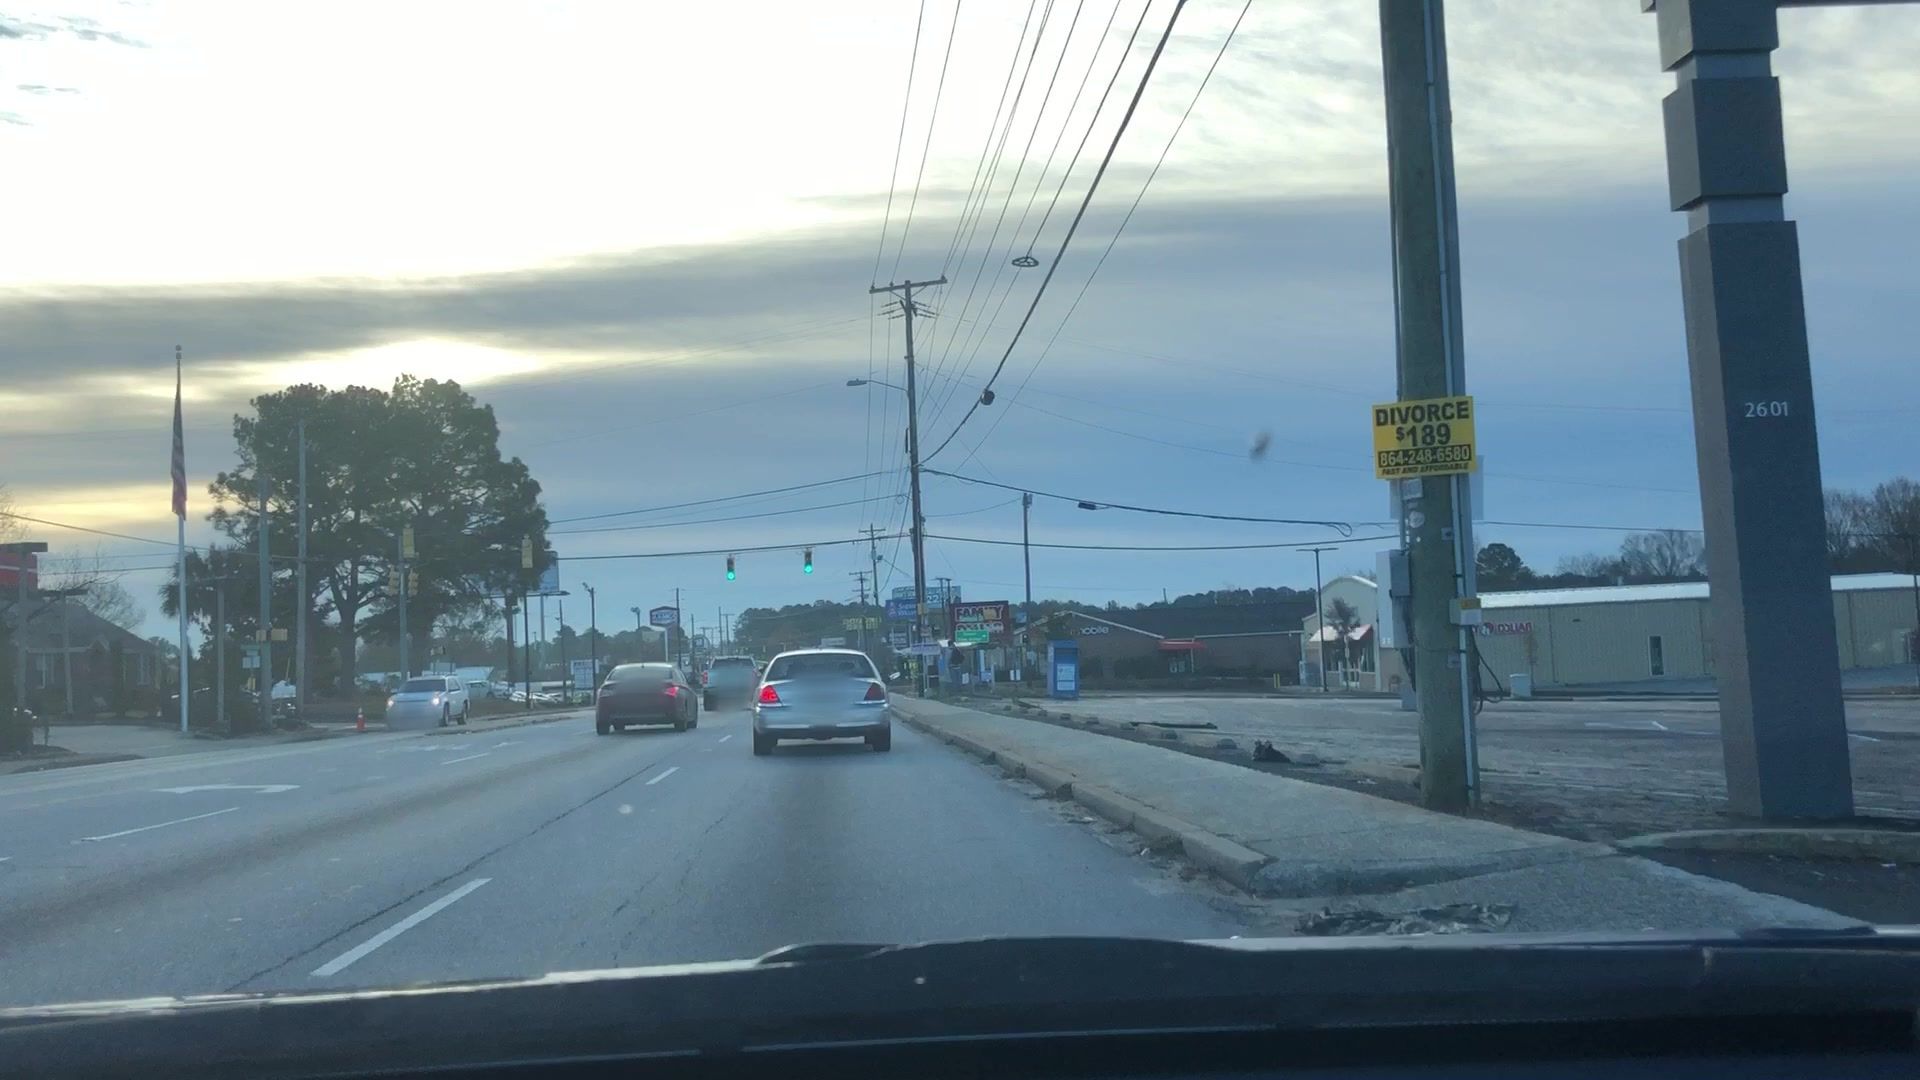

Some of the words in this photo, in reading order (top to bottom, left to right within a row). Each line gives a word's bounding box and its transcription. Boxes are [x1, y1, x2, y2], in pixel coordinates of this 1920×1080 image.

[1375, 400, 1469, 426] DIVORCE
[1744, 400, 1789, 418] 2601
[1396, 423, 1451, 448] $189
[1380, 445, 1470, 466] 864-248-6580
[1402, 465, 1418, 475] AND
[1419, 462, 1470, 474] AFFORDABLE
